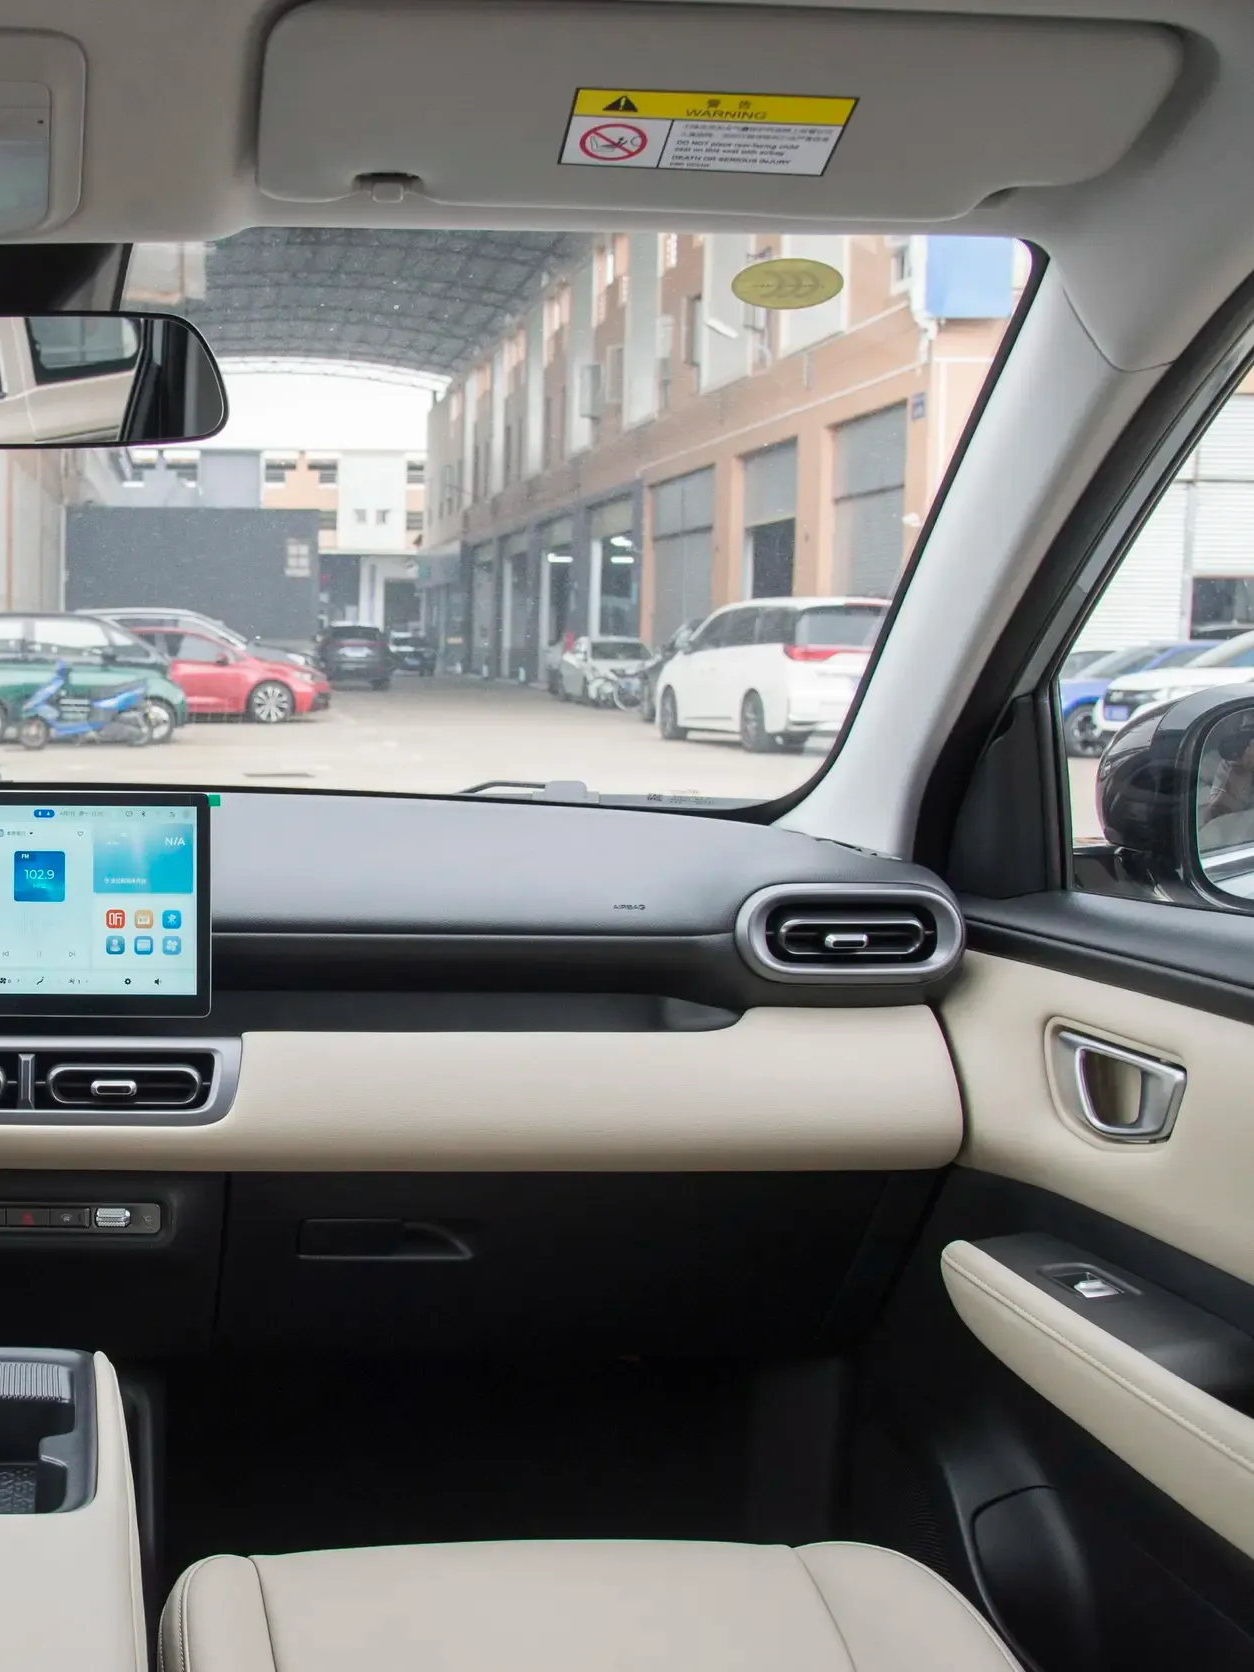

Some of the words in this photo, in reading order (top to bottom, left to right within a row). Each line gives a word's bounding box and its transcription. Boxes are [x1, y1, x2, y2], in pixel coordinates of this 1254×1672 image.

[686, 108, 767, 120] WARNING
[165, 837, 186, 846] N/A
[24, 869, 55, 880] 102.9
[109, 912, 123, 926] 听
